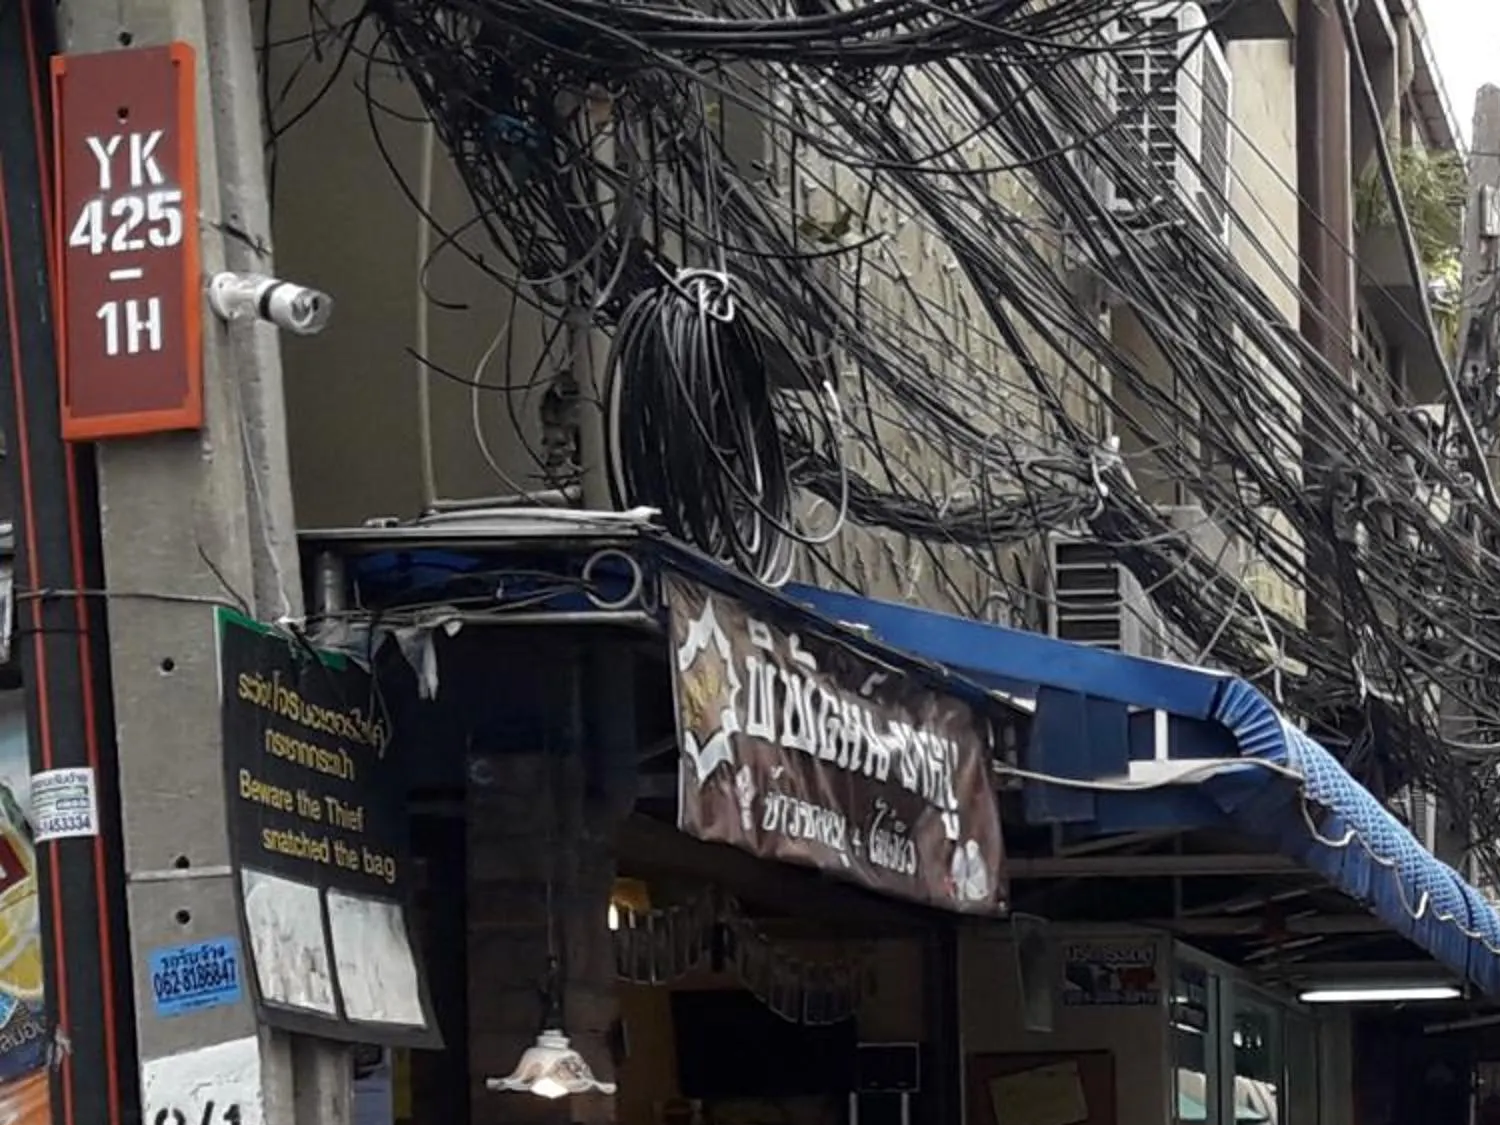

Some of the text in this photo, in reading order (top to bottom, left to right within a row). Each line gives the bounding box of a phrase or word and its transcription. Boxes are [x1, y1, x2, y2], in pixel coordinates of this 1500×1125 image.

[86, 130, 165, 190] YK
[69, 190, 184, 255] 425
[96, 298, 162, 356] 1H
[239, 768, 365, 833] Beware the Thief
[261, 827, 396, 885] snatched the bag
